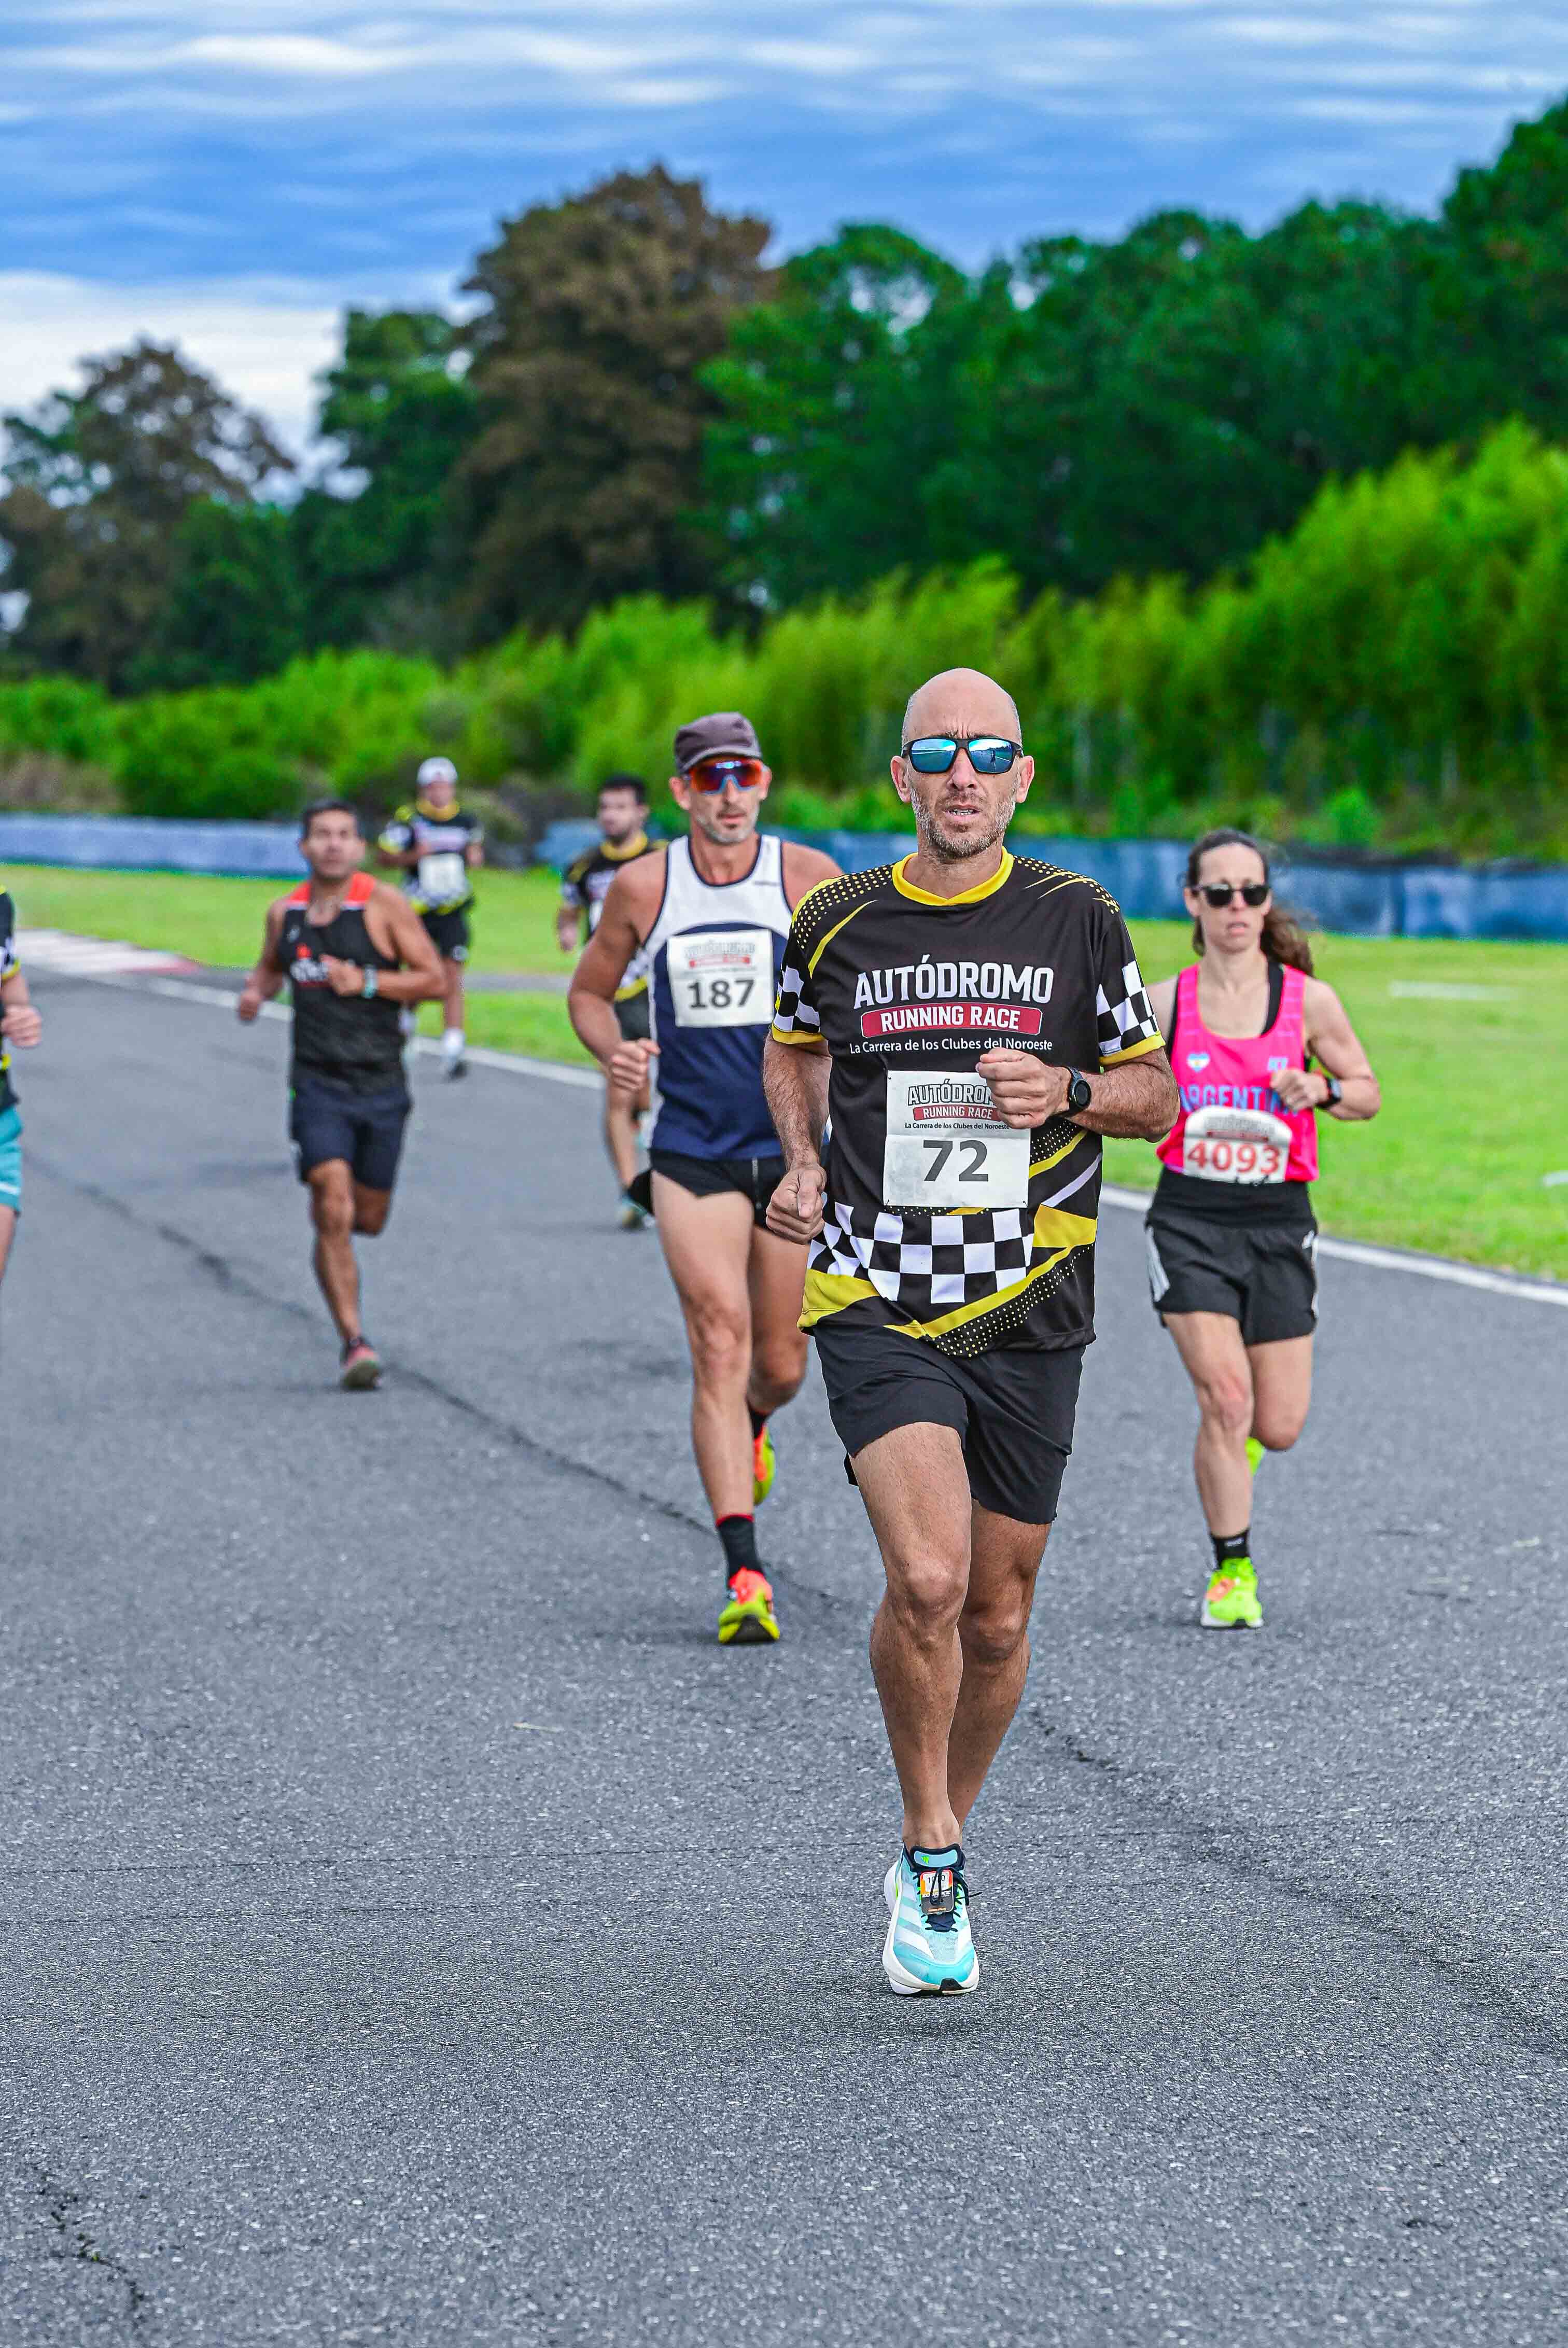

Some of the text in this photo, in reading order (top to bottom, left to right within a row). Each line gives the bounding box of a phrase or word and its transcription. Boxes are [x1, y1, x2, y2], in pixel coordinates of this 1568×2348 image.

[688, 979, 755, 1009] 187
[853, 954, 1054, 1009] AUTÓDROMO
[880, 1005, 1021, 1032] RUNNING RACE
[849, 1037, 1053, 1054] La Carrera de los Clubes del Noroeste
[908, 1078, 993, 1106] AUTÓDRO
[1180, 1084, 1298, 1115] RGENTIN
[922, 1106, 993, 1119] RUNNING RACE
[923, 1140, 989, 1182] 72
[1187, 1140, 1281, 1174] 4093
